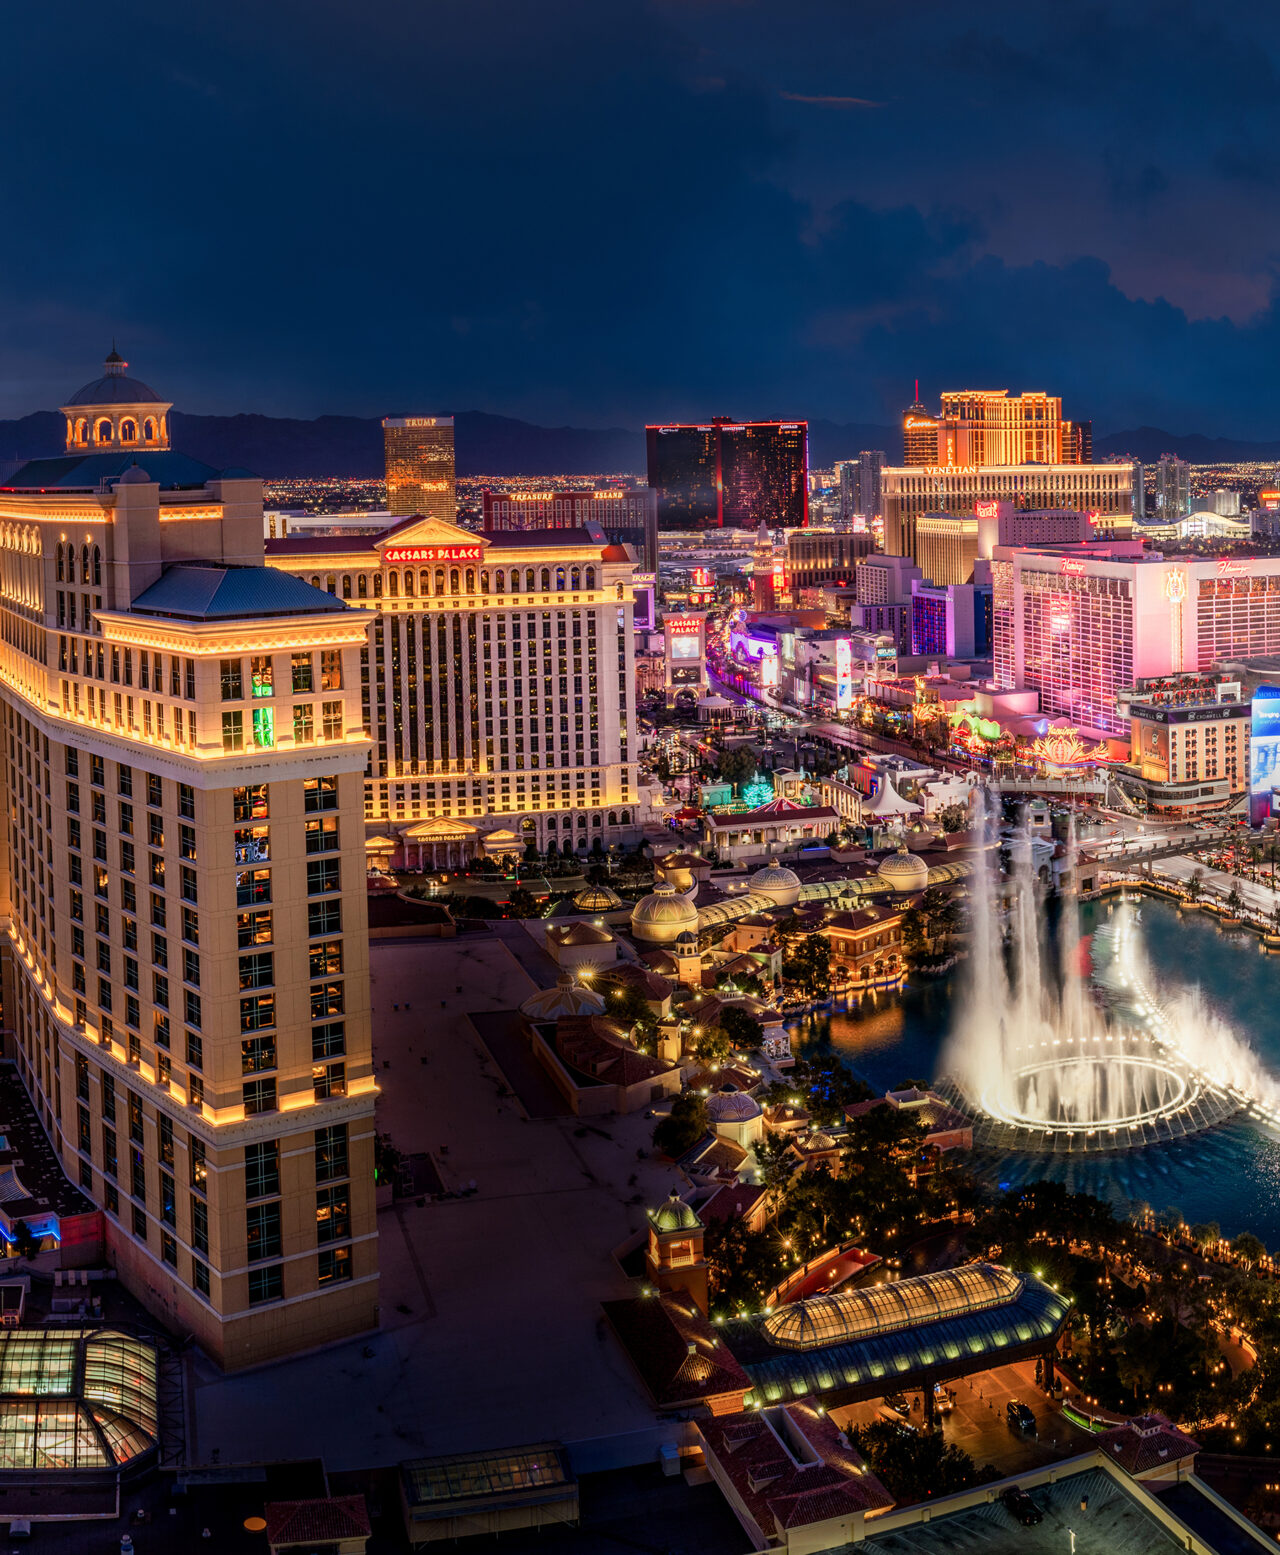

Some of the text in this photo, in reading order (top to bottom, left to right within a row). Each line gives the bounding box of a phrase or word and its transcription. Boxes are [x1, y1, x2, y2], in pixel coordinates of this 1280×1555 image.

[405, 418, 437, 427] TRUMP
[906, 417, 938, 429] Encore
[926, 466, 977, 475] VENETIAN
[510, 491, 624, 501] TREASURE ISLAND
[385, 548, 480, 561] CAESARS PALACE
[632, 574, 655, 582] IRAGE
